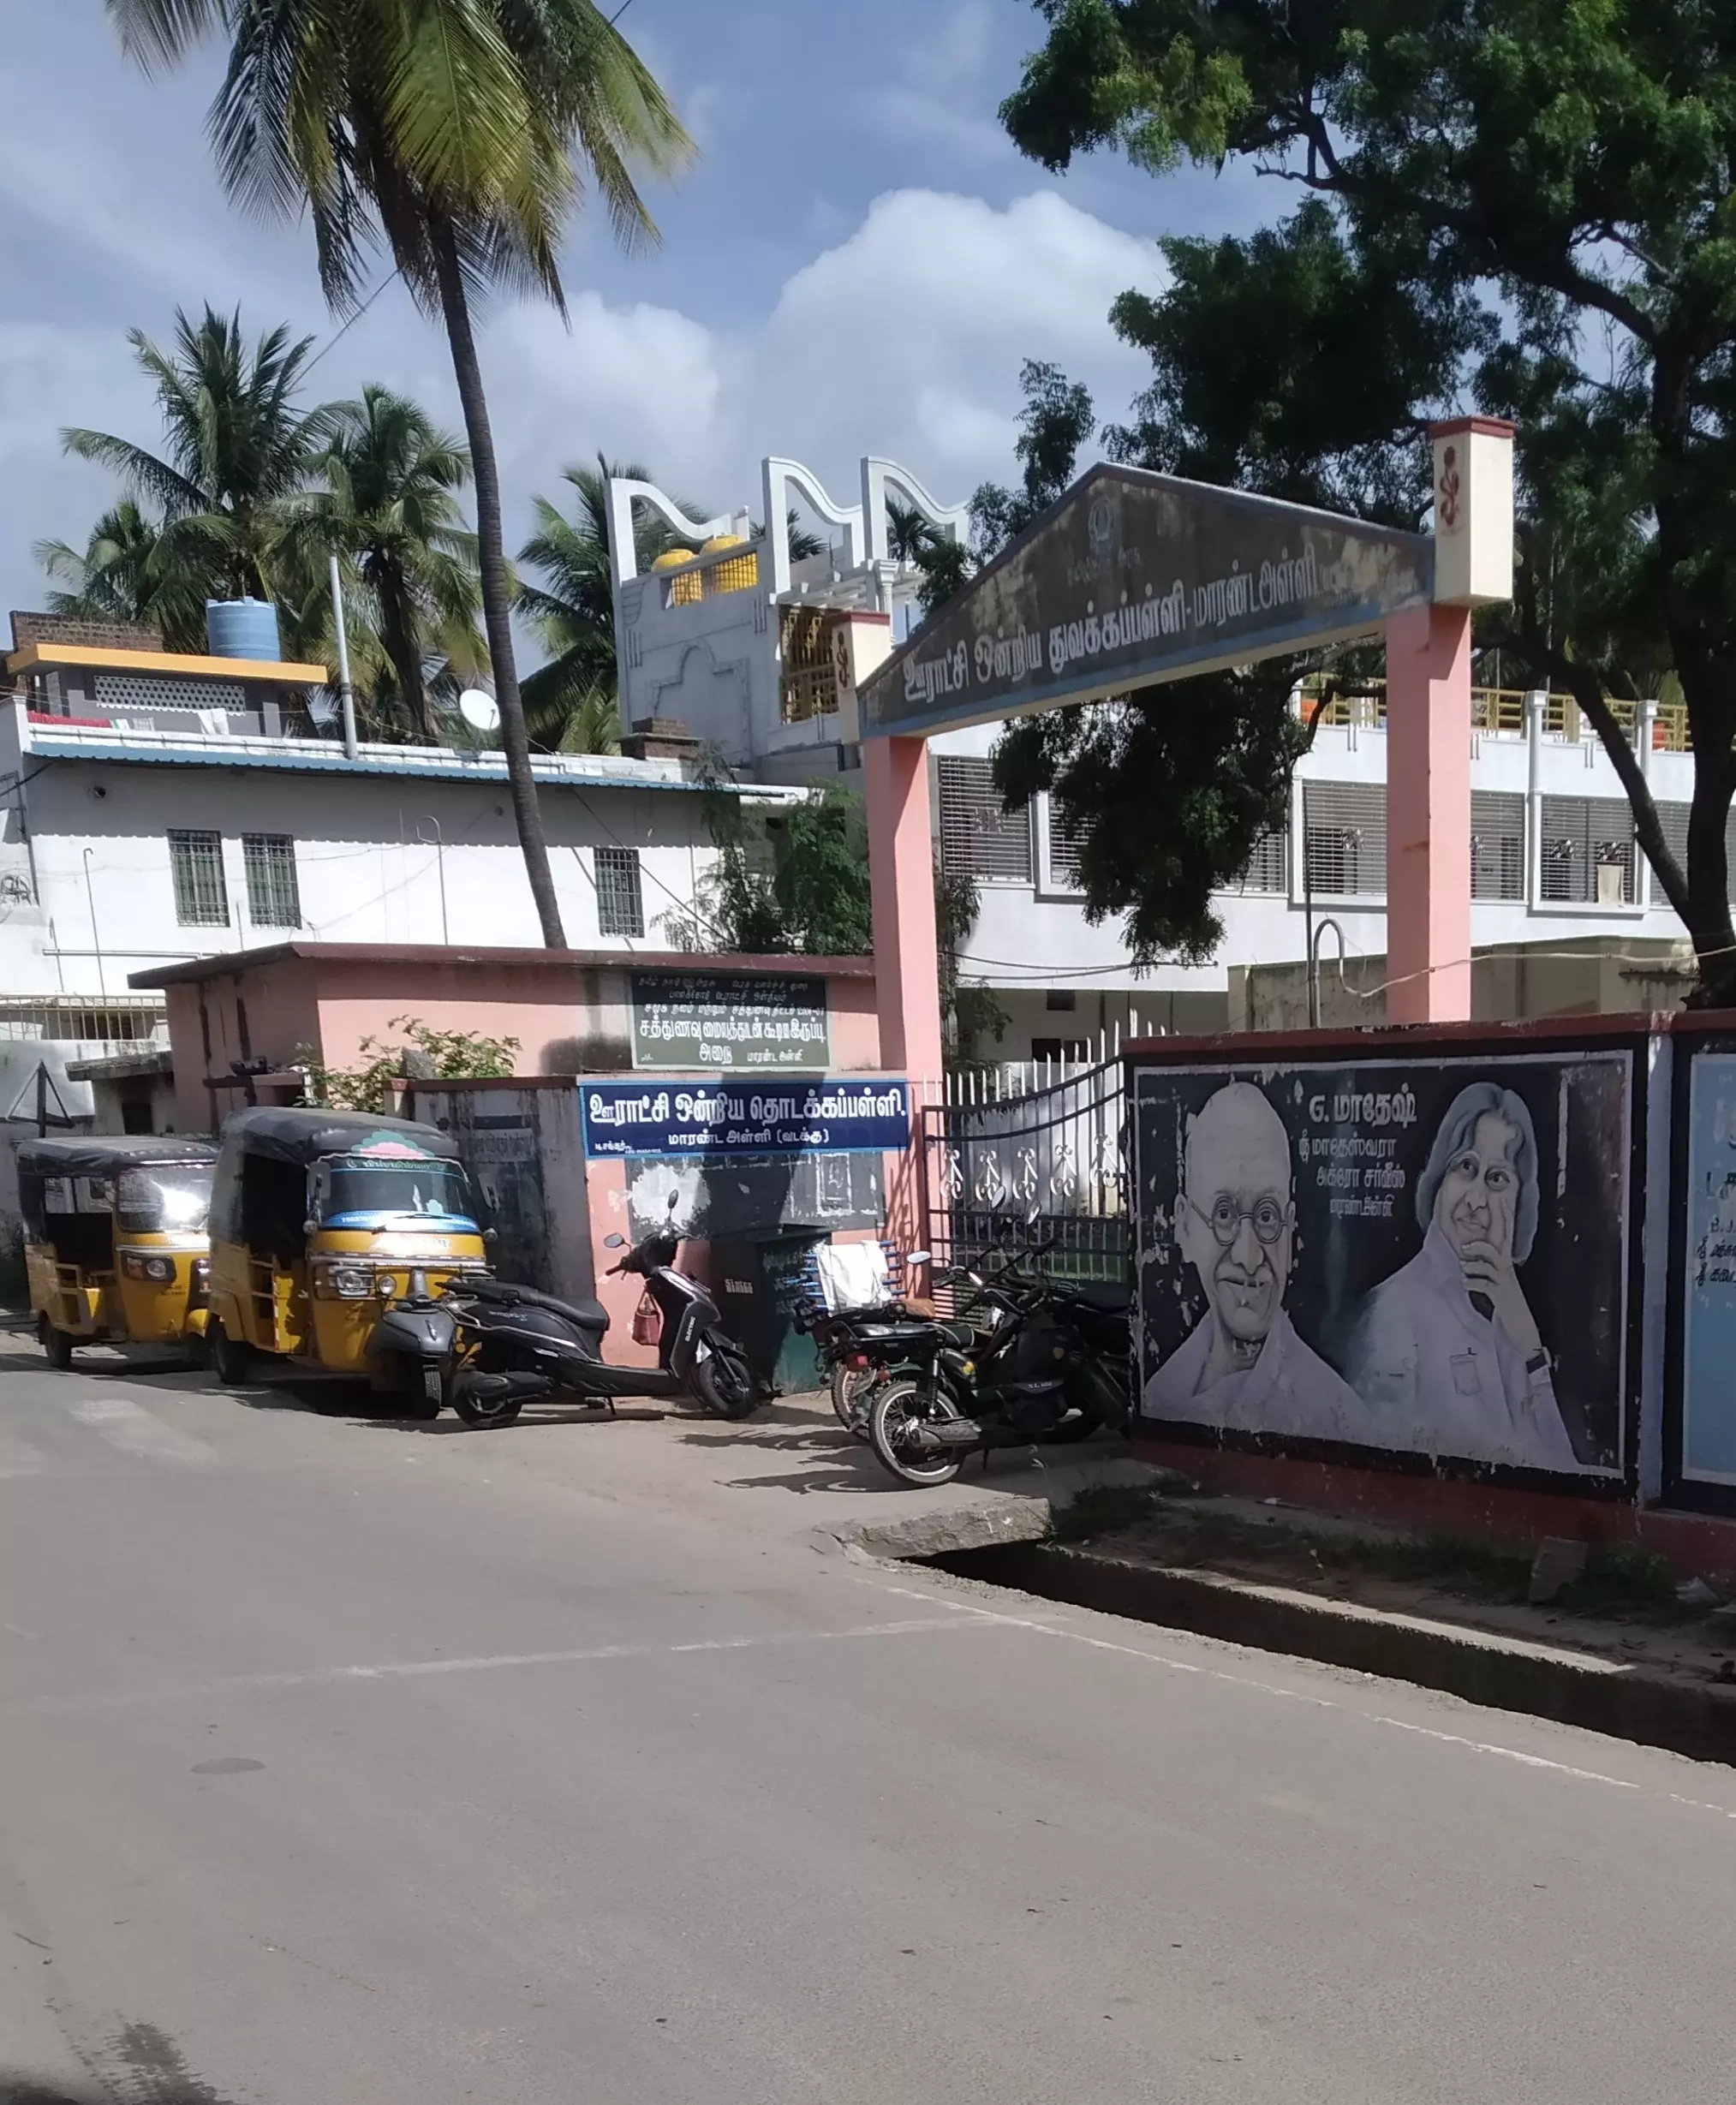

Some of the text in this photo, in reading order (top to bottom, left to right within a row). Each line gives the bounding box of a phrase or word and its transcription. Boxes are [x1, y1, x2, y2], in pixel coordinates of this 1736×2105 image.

[903, 640, 969, 703] ஊராட்சி
[974, 624, 1043, 683] ஒன்றிய
[589, 1092, 670, 1127] ஊராட்சி
[675, 1089, 744, 1127] ஒன்றிய
[1333, 1082, 1417, 1129] மாதேஷ்
[776, 1126, 830, 1144] (வடக்கு)
[1312, 1131, 1398, 1159] மாதேஸ்வரா
